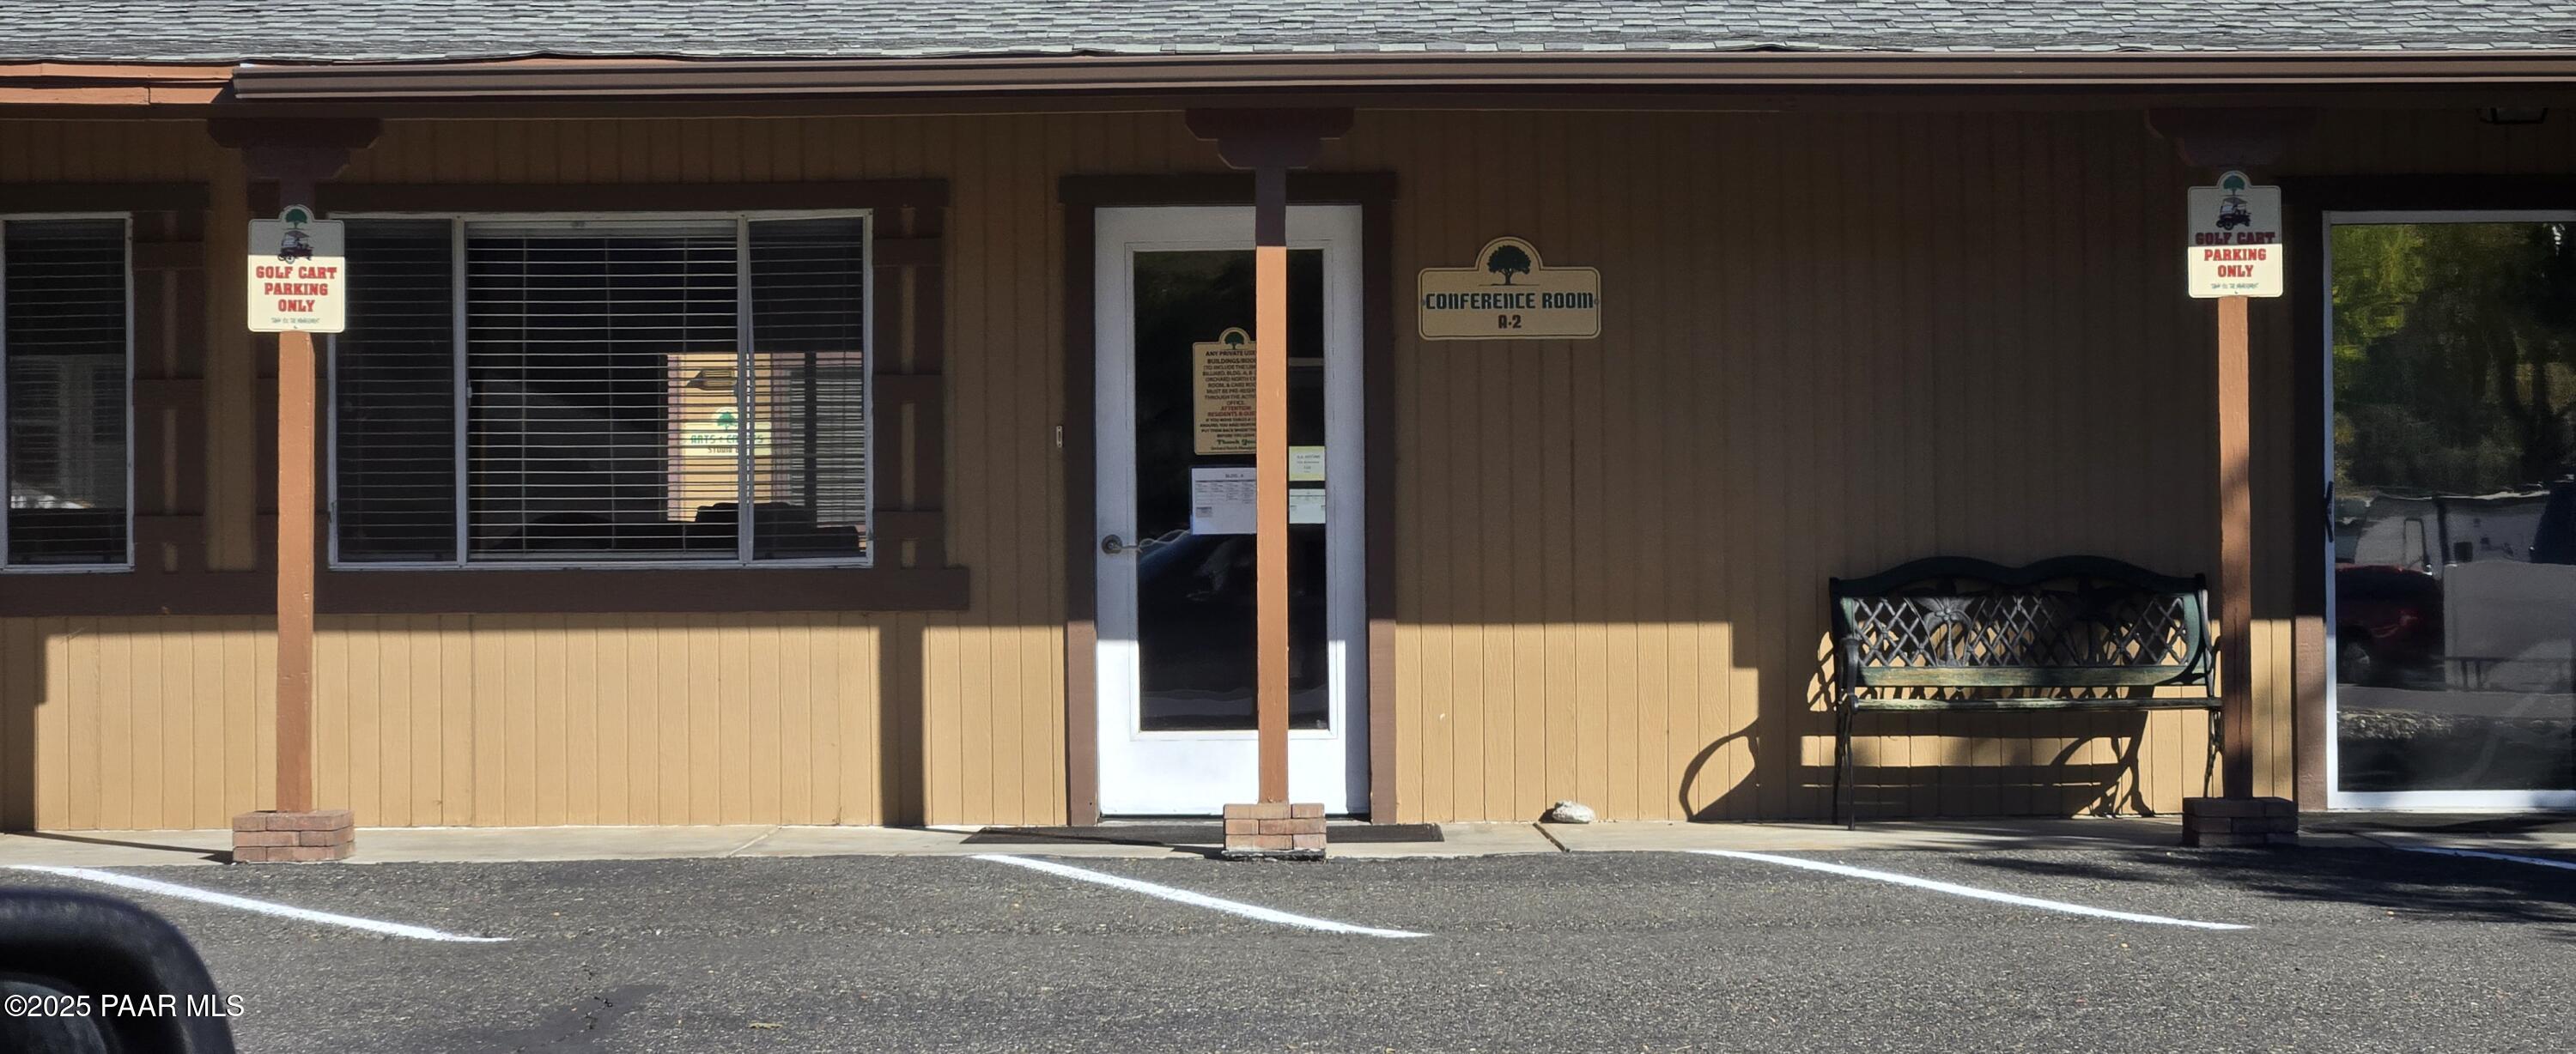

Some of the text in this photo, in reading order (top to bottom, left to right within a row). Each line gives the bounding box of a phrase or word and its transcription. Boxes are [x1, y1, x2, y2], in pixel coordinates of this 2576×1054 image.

[2195, 232, 2275, 245] GOLF CART
[2204, 248, 2267, 261] PARKING
[256, 266, 337, 279] GOLF CART
[2217, 264, 2254, 277] ONLY
[264, 282, 328, 295] PARKING
[278, 299, 315, 312] ONLY
[1426, 292, 1594, 310] CONFERENCE ROOM
